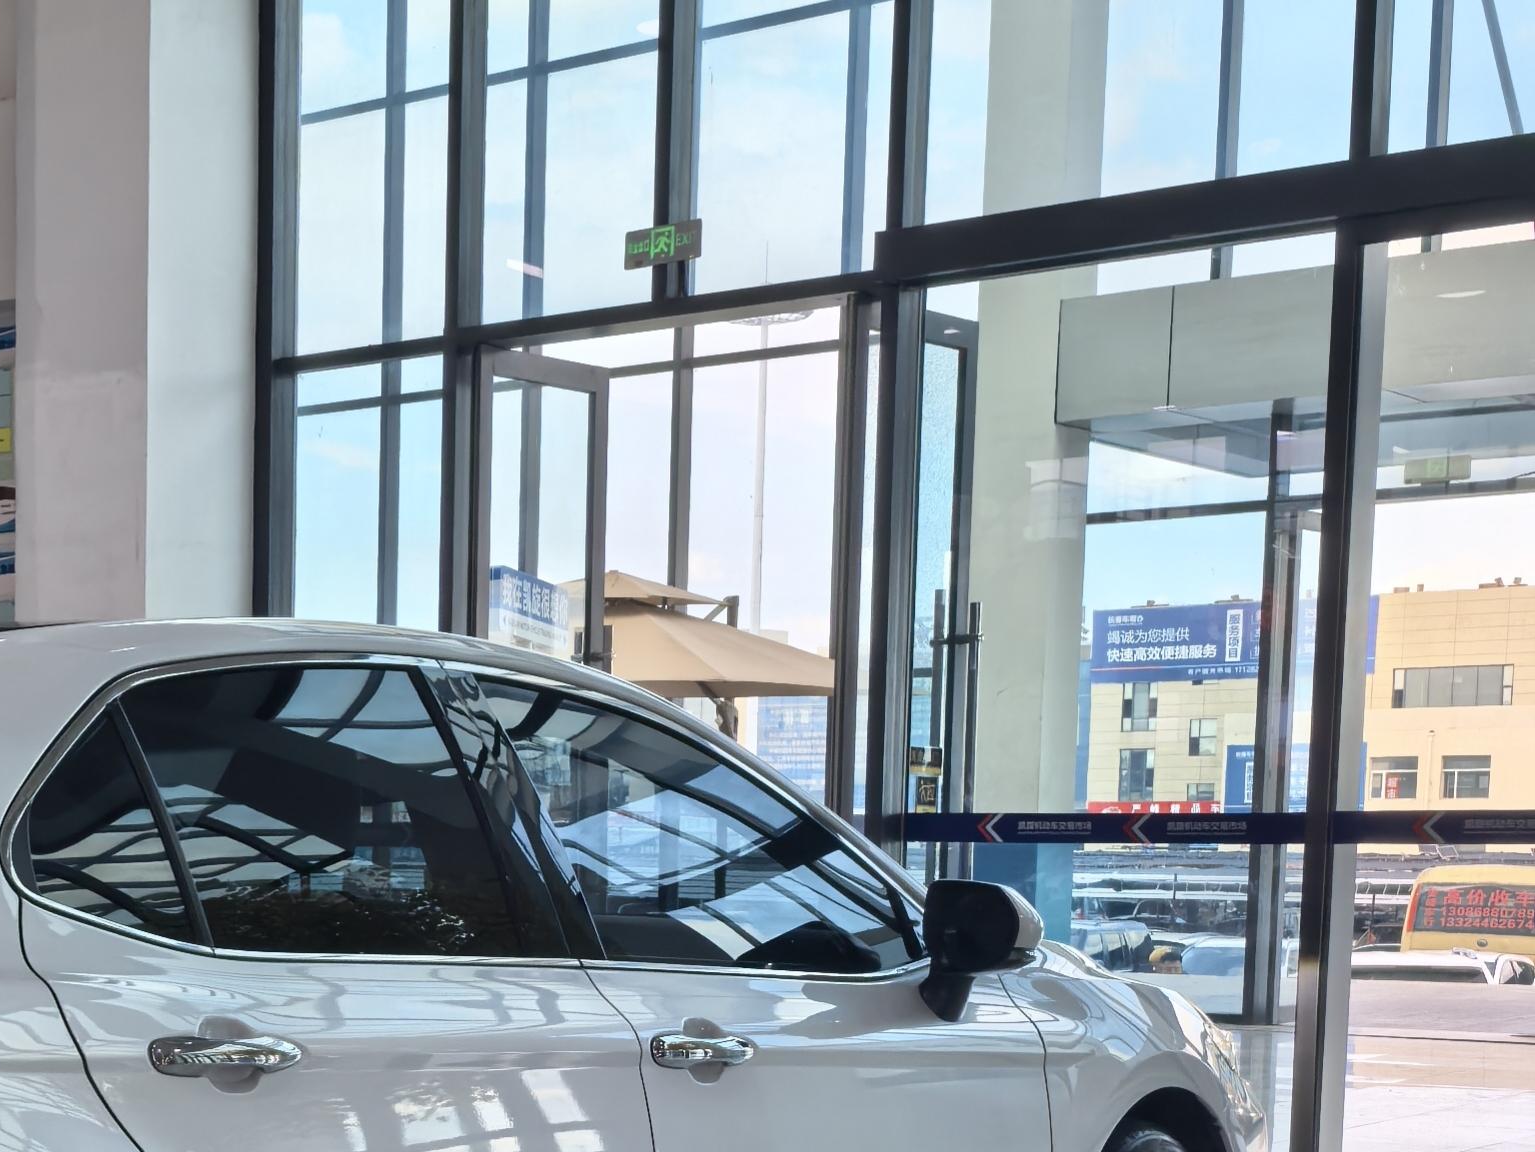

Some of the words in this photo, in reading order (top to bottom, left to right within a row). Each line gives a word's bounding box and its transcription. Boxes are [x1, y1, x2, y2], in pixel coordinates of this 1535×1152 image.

[1107, 627, 1189, 644] 竭诚为您提供
[1228, 613, 1241, 659] 服务项目
[1107, 643, 1216, 662] 快速高效便捷服务
